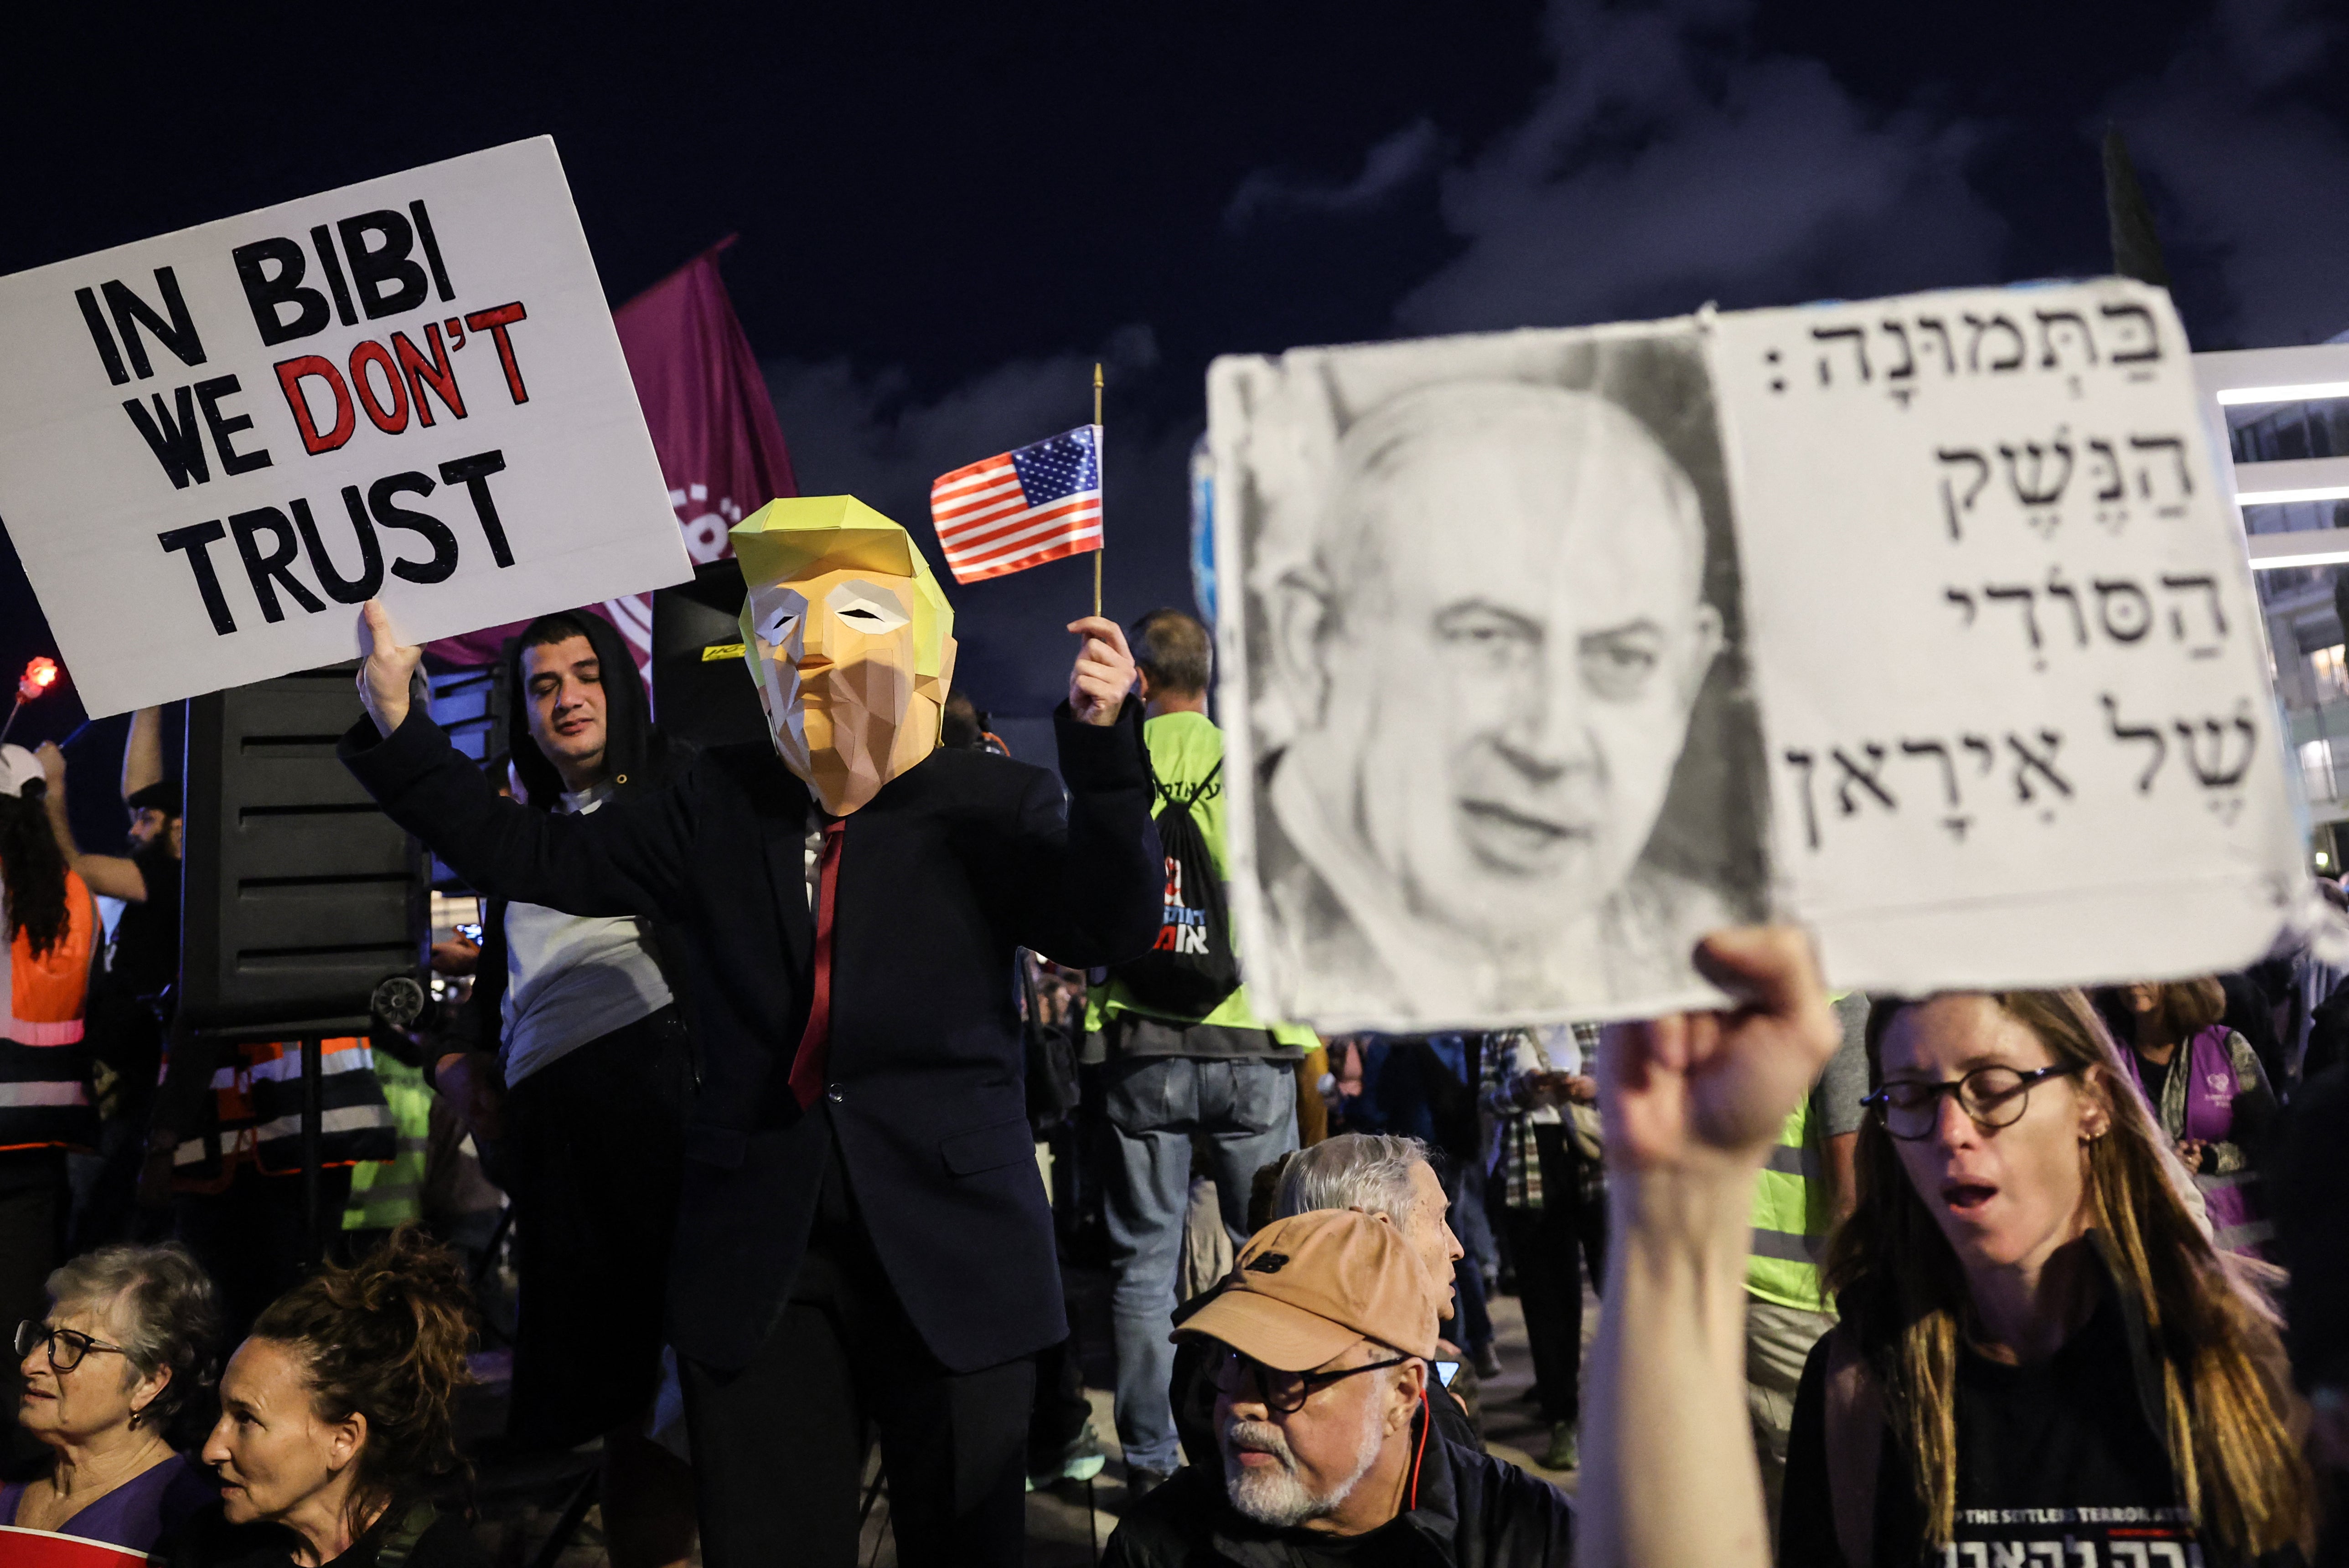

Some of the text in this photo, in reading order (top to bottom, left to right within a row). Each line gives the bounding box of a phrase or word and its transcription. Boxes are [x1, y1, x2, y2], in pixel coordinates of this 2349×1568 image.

[75, 199, 455, 386] IN BIBI
[122, 301, 529, 490] WE DON'T
[157, 449, 515, 635] TRUST
[1966, 1509, 1998, 1524] THE
